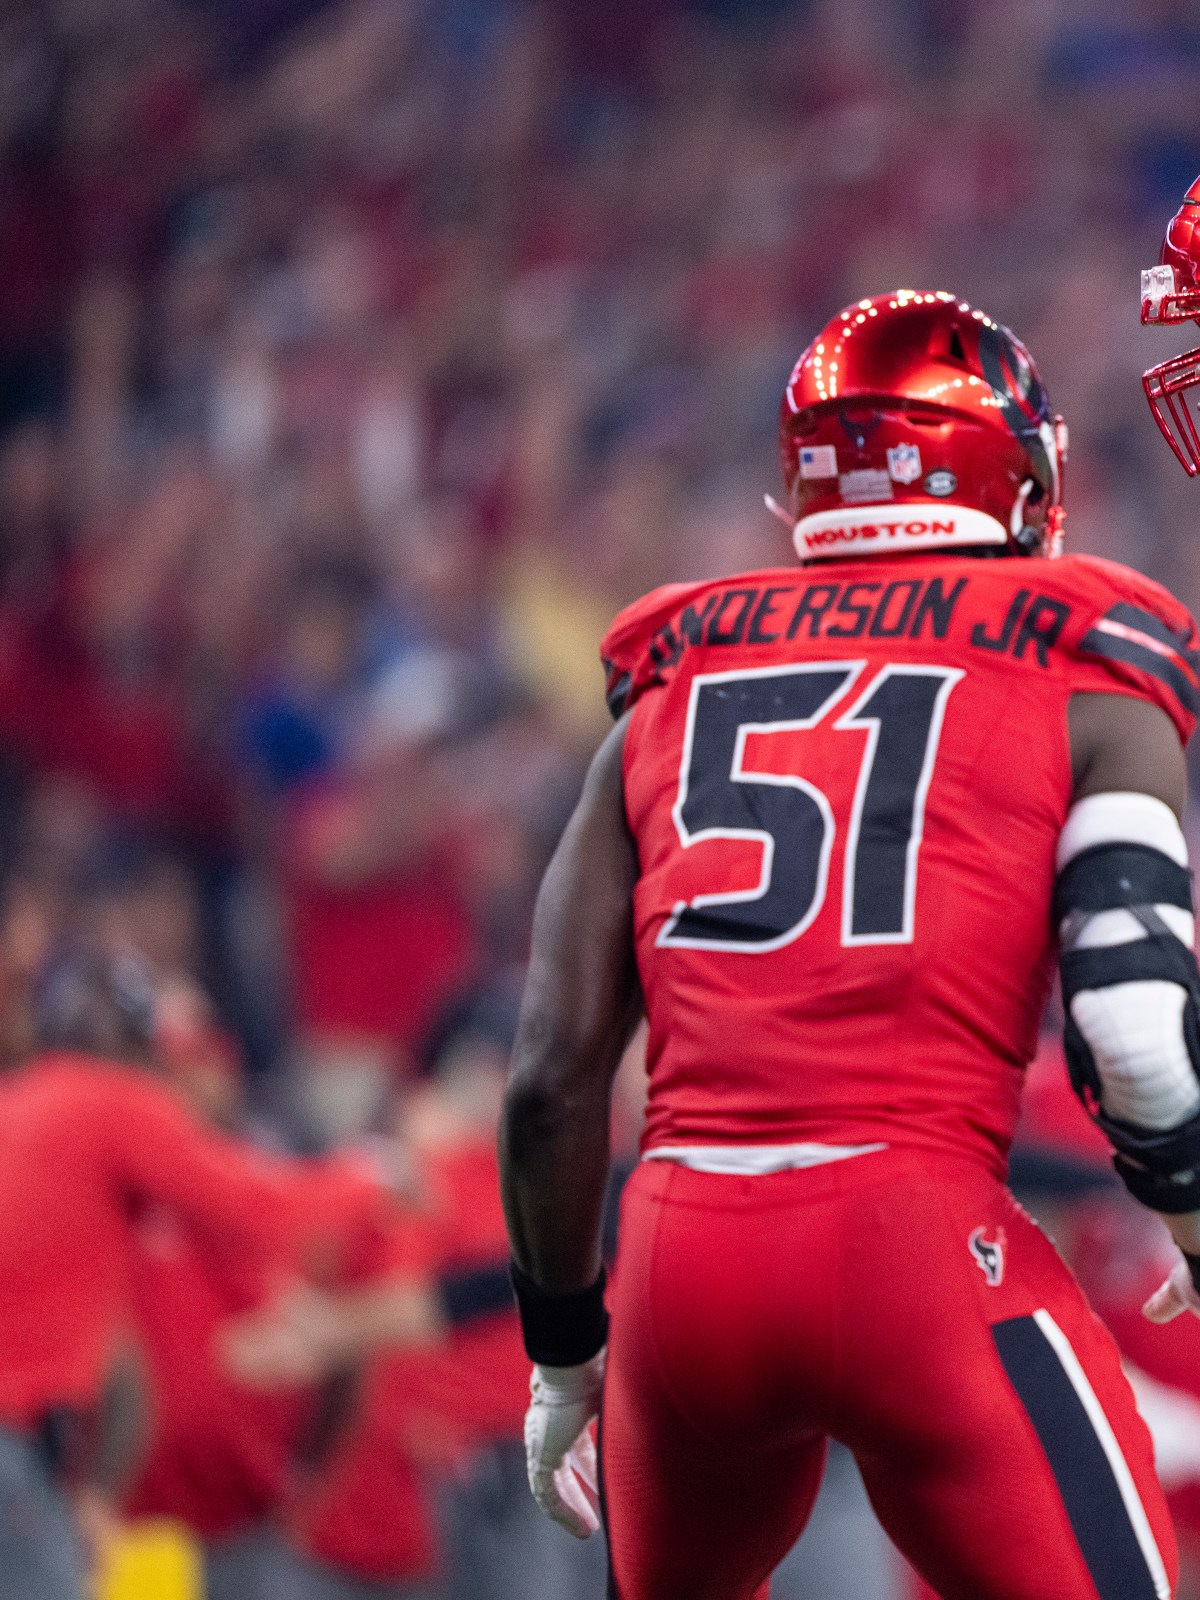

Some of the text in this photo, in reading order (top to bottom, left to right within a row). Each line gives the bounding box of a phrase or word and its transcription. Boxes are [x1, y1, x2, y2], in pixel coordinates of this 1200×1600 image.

[803, 520, 955, 548] HOUSTON
[970, 589, 1071, 668] JR
[655, 659, 966, 954] 51
